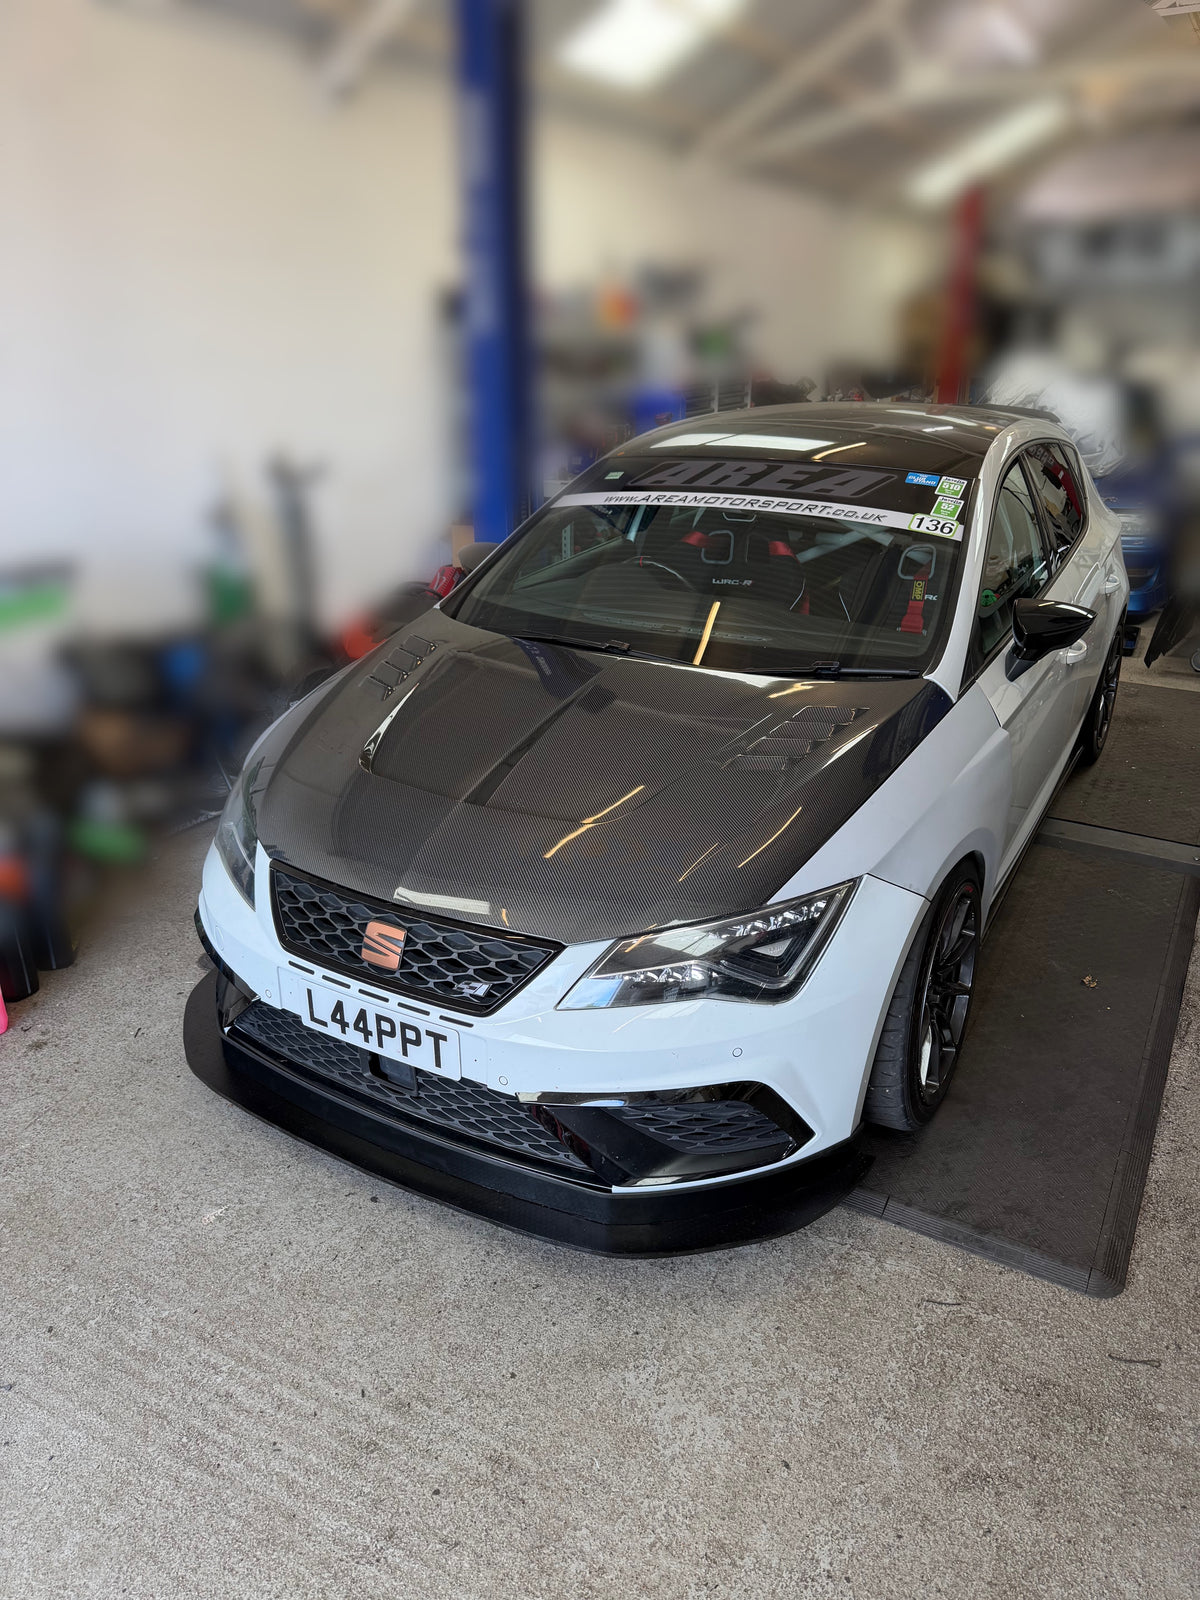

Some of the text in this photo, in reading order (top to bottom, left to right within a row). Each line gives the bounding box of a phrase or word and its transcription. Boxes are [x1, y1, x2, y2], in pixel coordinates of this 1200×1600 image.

[630, 461, 897, 497] AREA
[915, 516, 955, 535] 136
[914, 581, 923, 600] OMP
[306, 987, 448, 1069] L44PPT
